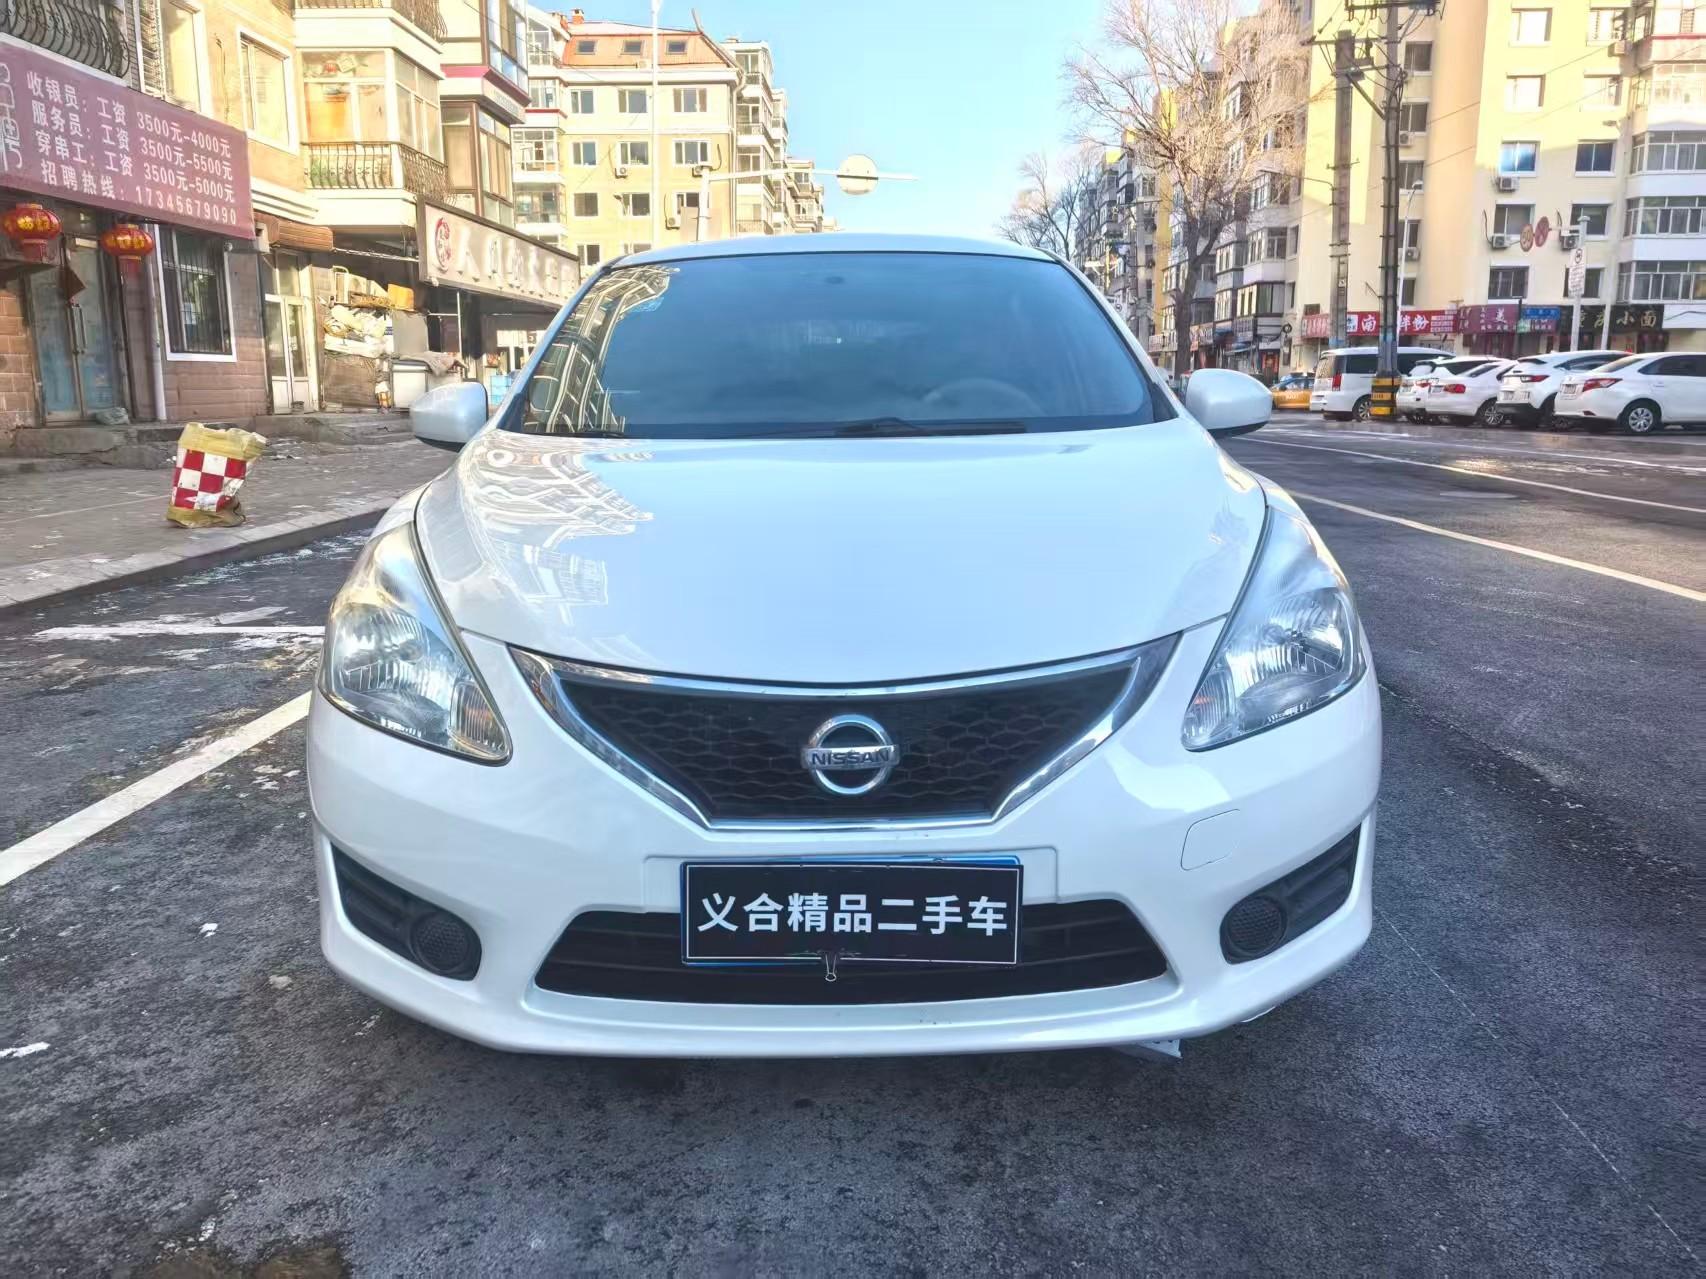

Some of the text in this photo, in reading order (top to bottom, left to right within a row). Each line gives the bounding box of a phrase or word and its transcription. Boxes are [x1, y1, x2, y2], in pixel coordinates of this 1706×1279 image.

[97, 96, 126, 126] 工资
[137, 112, 231, 158] 3500元-4000元
[101, 124, 129, 151] 工资
[140, 137, 232, 180] 3500元-5500元
[104, 150, 132, 176] 工资
[144, 162, 235, 202] 3500元-5000元
[136, 185, 236, 225] 17345679090
[812, 747, 889, 766] NISSAN
[697, 892, 1007, 936] 义合精品二手车
